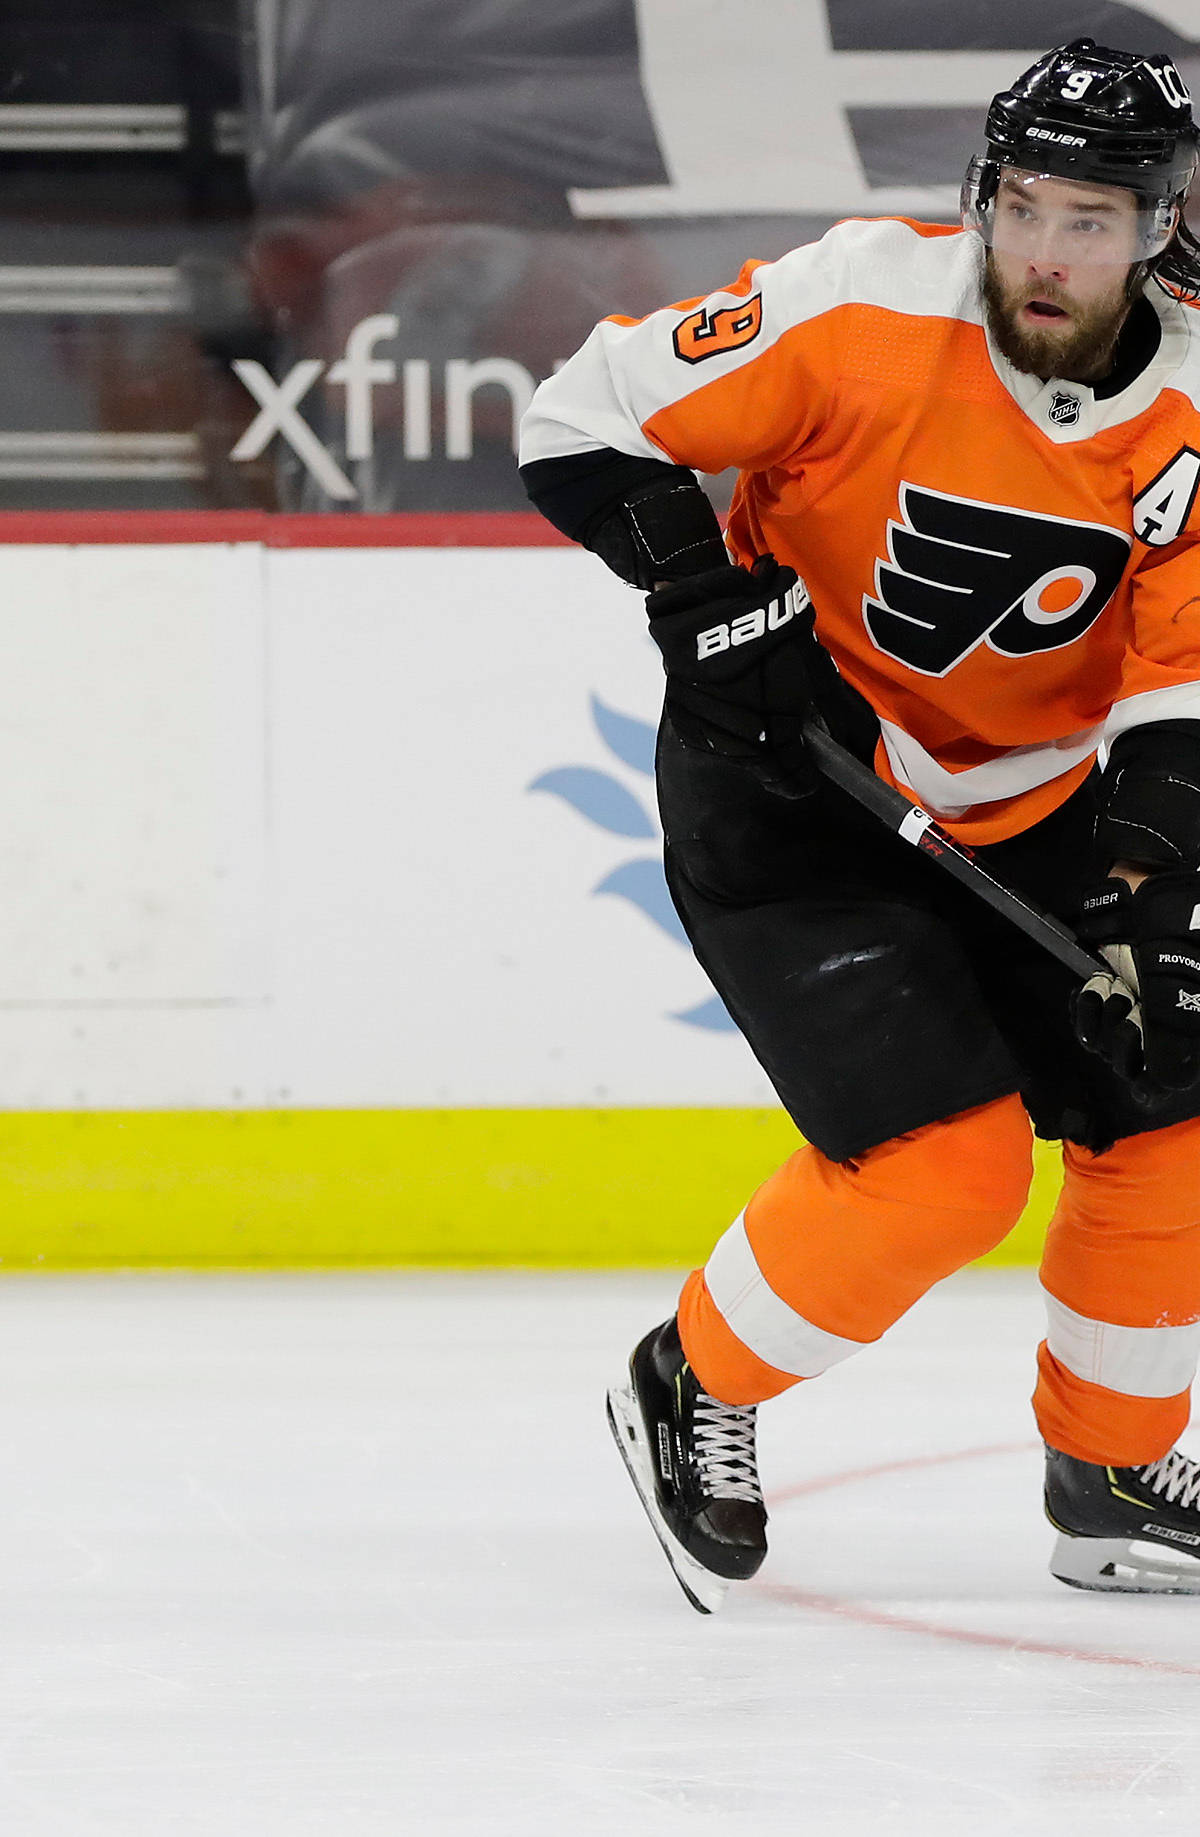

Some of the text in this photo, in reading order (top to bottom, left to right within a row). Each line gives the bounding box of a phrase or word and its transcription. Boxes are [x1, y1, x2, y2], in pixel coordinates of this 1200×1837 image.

[1060, 72, 1094, 101] 9
[1025, 125, 1088, 149] BAUER
[671, 290, 763, 366] 9
[230, 314, 568, 501] xfin
[696, 575, 812, 661] BAUE
